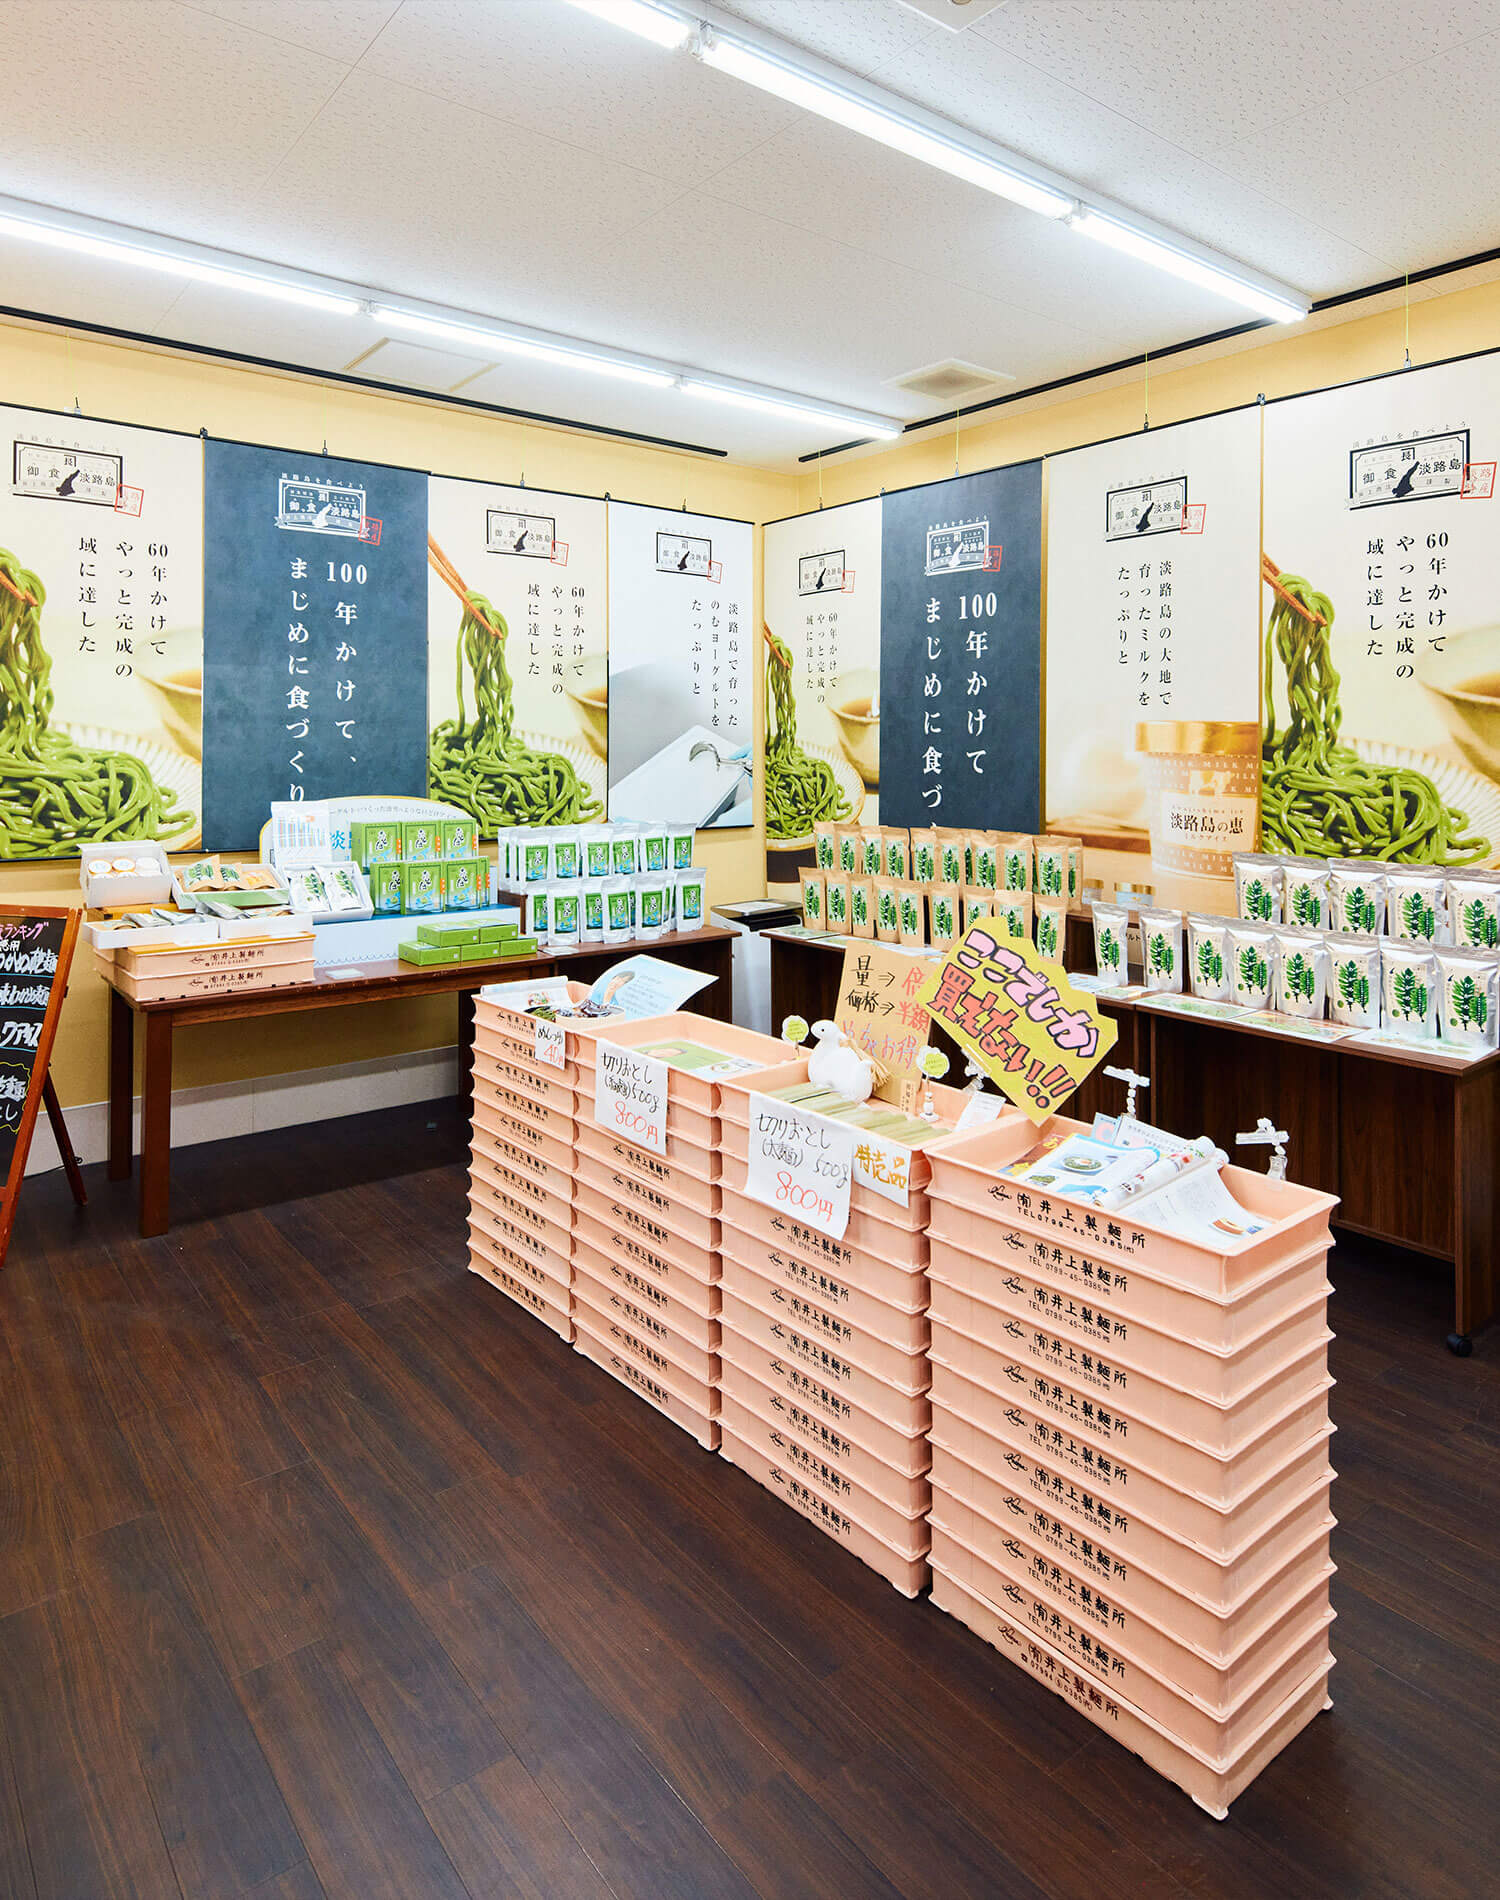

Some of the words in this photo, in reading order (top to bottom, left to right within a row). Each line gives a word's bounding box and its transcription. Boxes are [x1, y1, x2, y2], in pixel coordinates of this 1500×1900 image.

[78, 536, 97, 653] 域に達した
[115, 540, 134, 679] やっと完成の
[148, 542, 169, 657] 60年かけて
[528, 583, 540, 676] 域に達した
[551, 585, 563, 695] やっと完成の
[571, 586, 585, 677] 60年かけて
[1117, 566, 1131, 665] たっぷりと
[1138, 563, 1151, 707] 育ったミルクを
[1159, 560, 1172, 706] 淡路島の大地で
[1366, 538, 1384, 656] 域に達した
[1396, 535, 1415, 679] やっと完成の
[1426, 531, 1449, 653] 60年かけて
[285, 556, 311, 802] まじめに食づくり
[326, 560, 369, 765] 100年かけて、
[692, 599, 702, 695] たっぷりと
[710, 599, 720, 727] のむヨーグルトを
[728, 602, 739, 727] 淡路島で育った
[806, 615, 814, 689] 域に達した
[817, 613, 825, 704] やっと完成の
[828, 611, 838, 688] 60年かけて
[958, 591, 998, 775] 100年かけて
[922, 597, 942, 827] まじめに食づ
[1171, 812, 1244, 834] 淡路島の恵
[845, 989, 880, 1014] 価格
[895, 1000, 932, 1035] 半額
[850, 955, 874, 988] 量
[957, 928, 1100, 1058] ここでしか
[600, 1052, 653, 1085] 切りおとし
[615, 1100, 658, 1145] 800円
[755, 1113, 831, 1150] 切りおとし
[813, 1153, 850, 1190] 500g
[854, 1143, 908, 1190] 特売品
[775, 1170, 834, 1223] 800円
